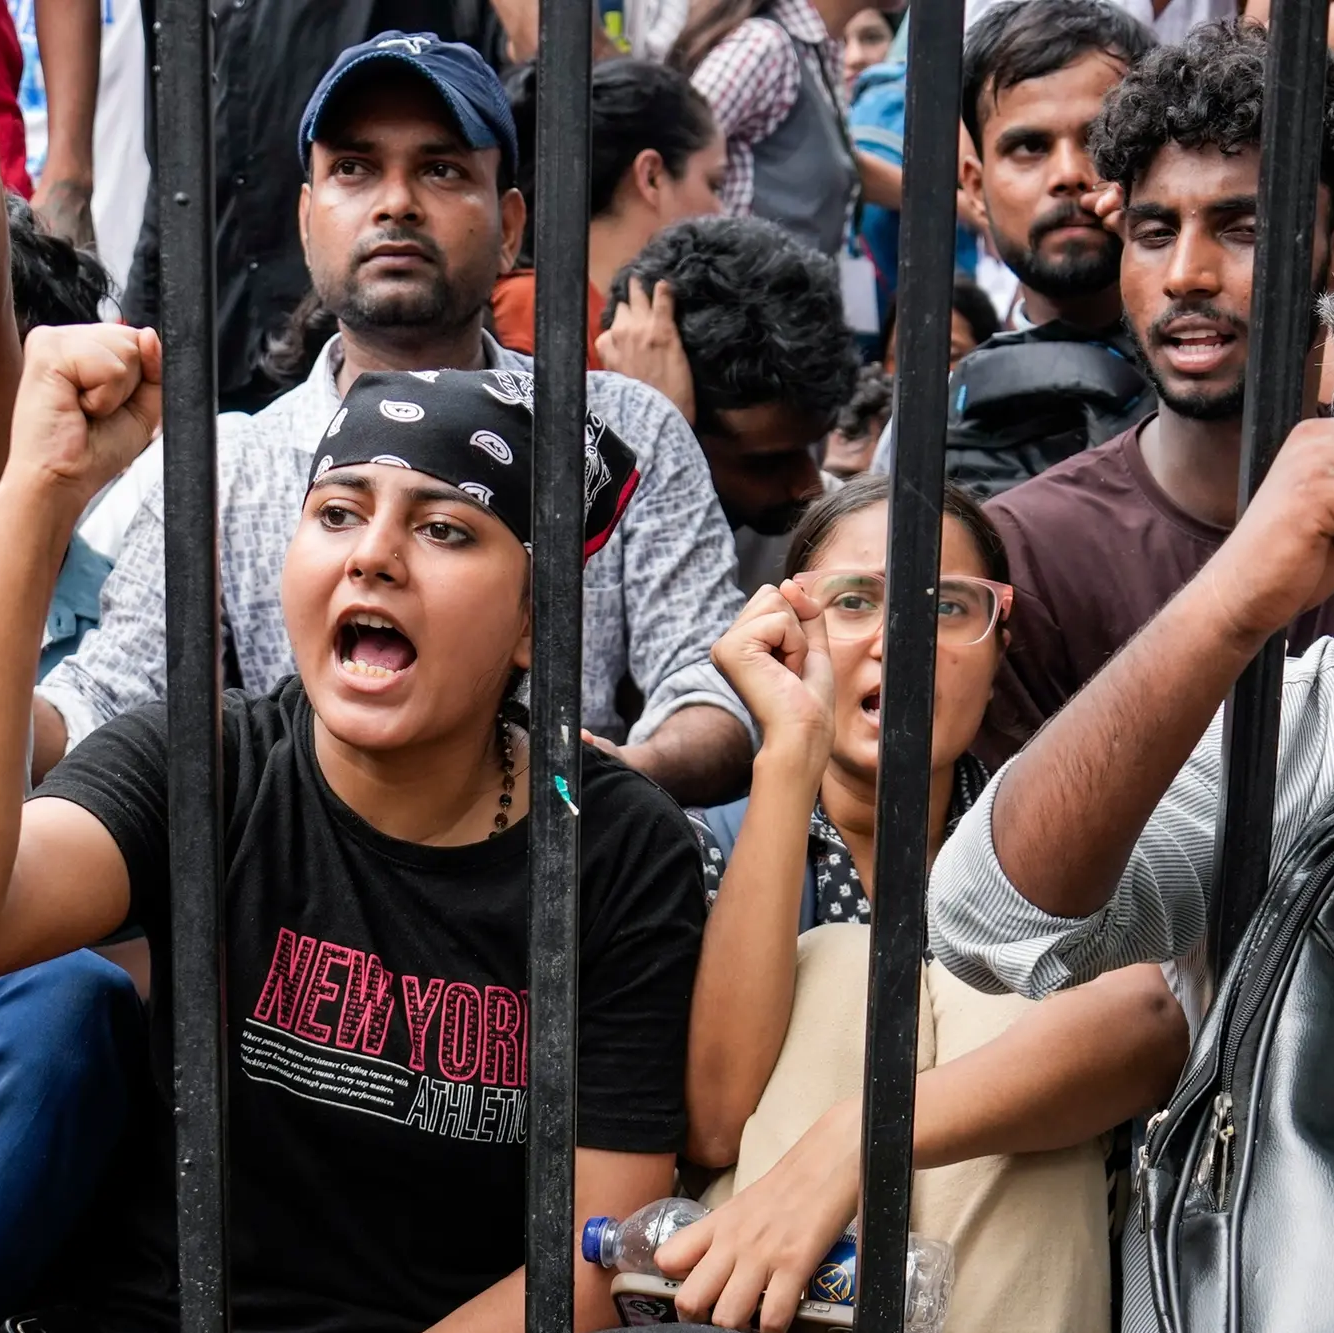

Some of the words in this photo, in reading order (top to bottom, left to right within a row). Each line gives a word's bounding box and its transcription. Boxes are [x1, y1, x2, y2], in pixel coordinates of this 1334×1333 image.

[253, 927, 394, 1056] NEW
[242, 1030, 262, 1043] Where
[261, 1038, 286, 1052] passion
[286, 1046, 304, 1059] meets
[340, 1062, 369, 1078] Crafting
[369, 1069, 394, 1083] legends
[394, 1076, 409, 1088] with
[254, 1047, 272, 1059] move
[272, 1052, 290, 1066] Every
[290, 1060, 313, 1075] second
[312, 1068, 336, 1081] counts,
[336, 1074, 355, 1085] every
[355, 1078, 369, 1089] step
[370, 1082, 394, 1095] matters
[265, 1063, 294, 1079] potential
[293, 1073, 320, 1089] through
[319, 1081, 350, 1096] powerful
[349, 1088, 394, 1107] performances
